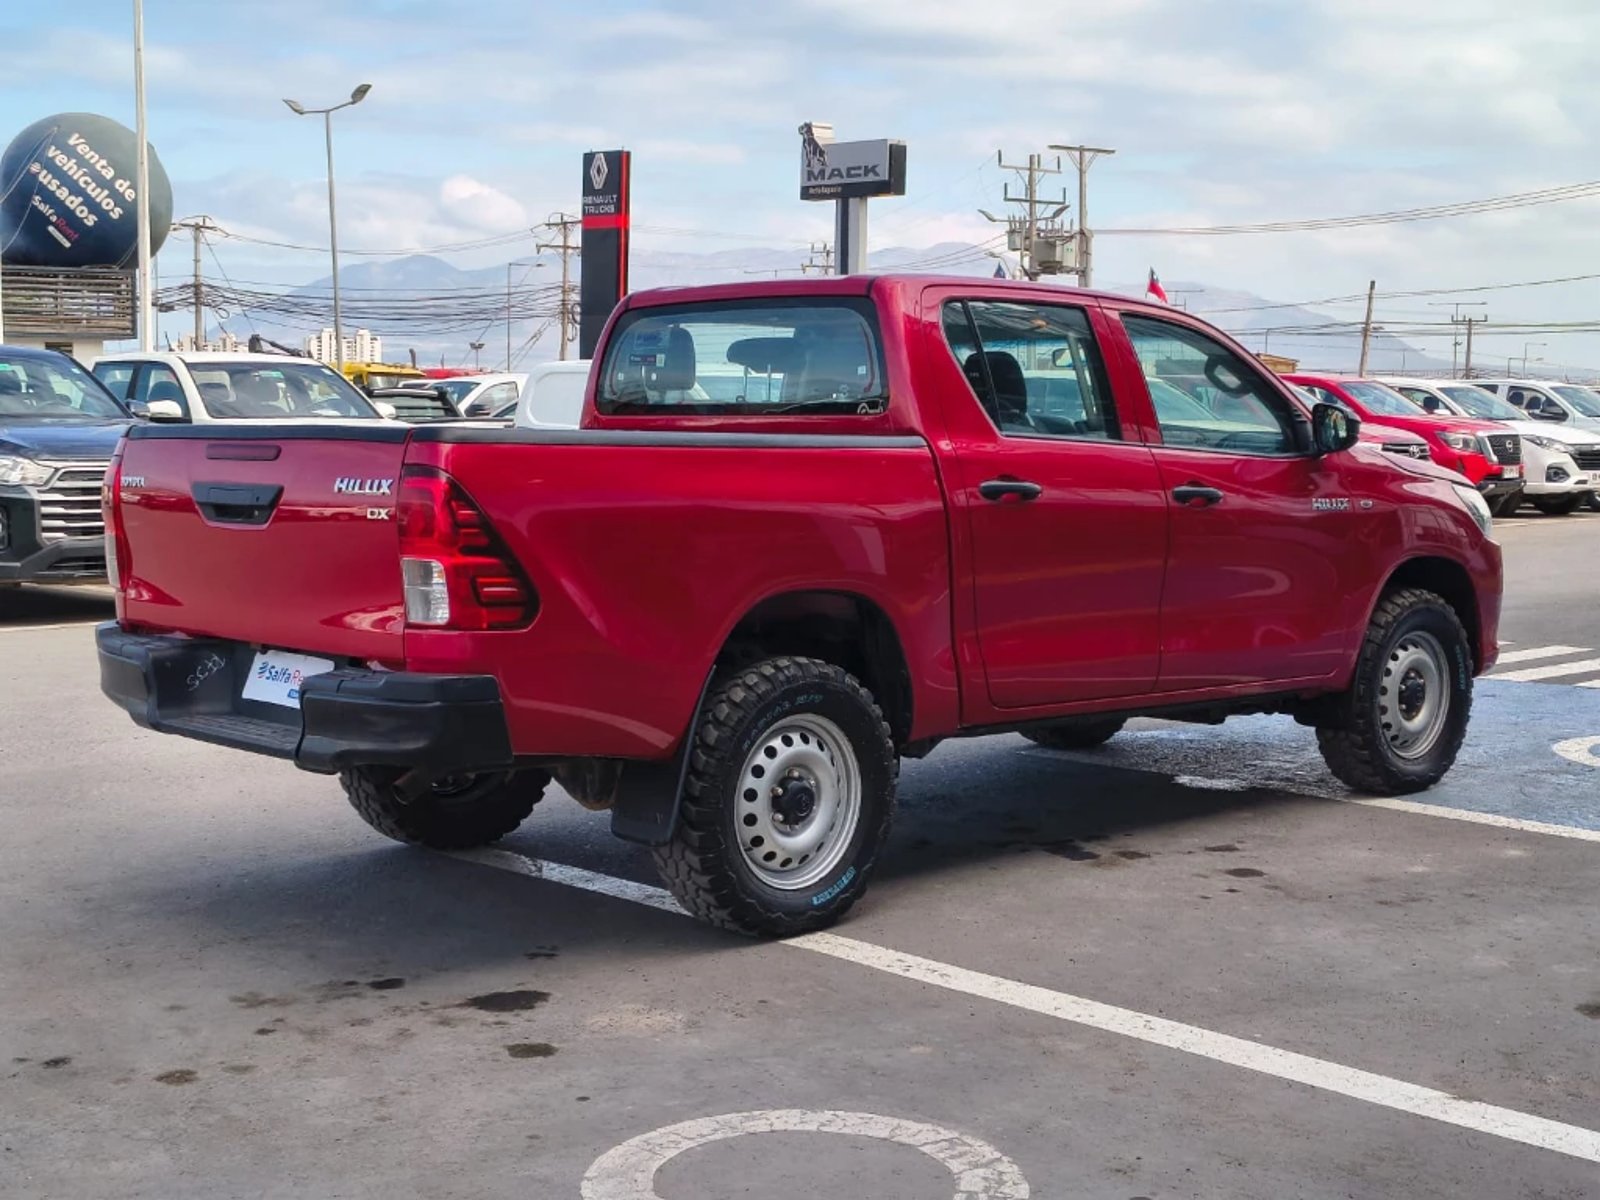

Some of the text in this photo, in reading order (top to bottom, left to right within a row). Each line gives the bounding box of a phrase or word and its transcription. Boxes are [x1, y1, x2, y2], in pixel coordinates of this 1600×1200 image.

[67, 132, 136, 202] Venta de
[807, 164, 881, 182] MACK
[47, 145, 124, 220] vehículos
[38, 170, 98, 227] usados
[583, 194, 618, 204] RENAULT
[584, 204, 615, 214] TRUCKS
[334, 477, 394, 495] HILUX
[1311, 497, 1350, 511] HILUX
[366, 507, 390, 520] DX
